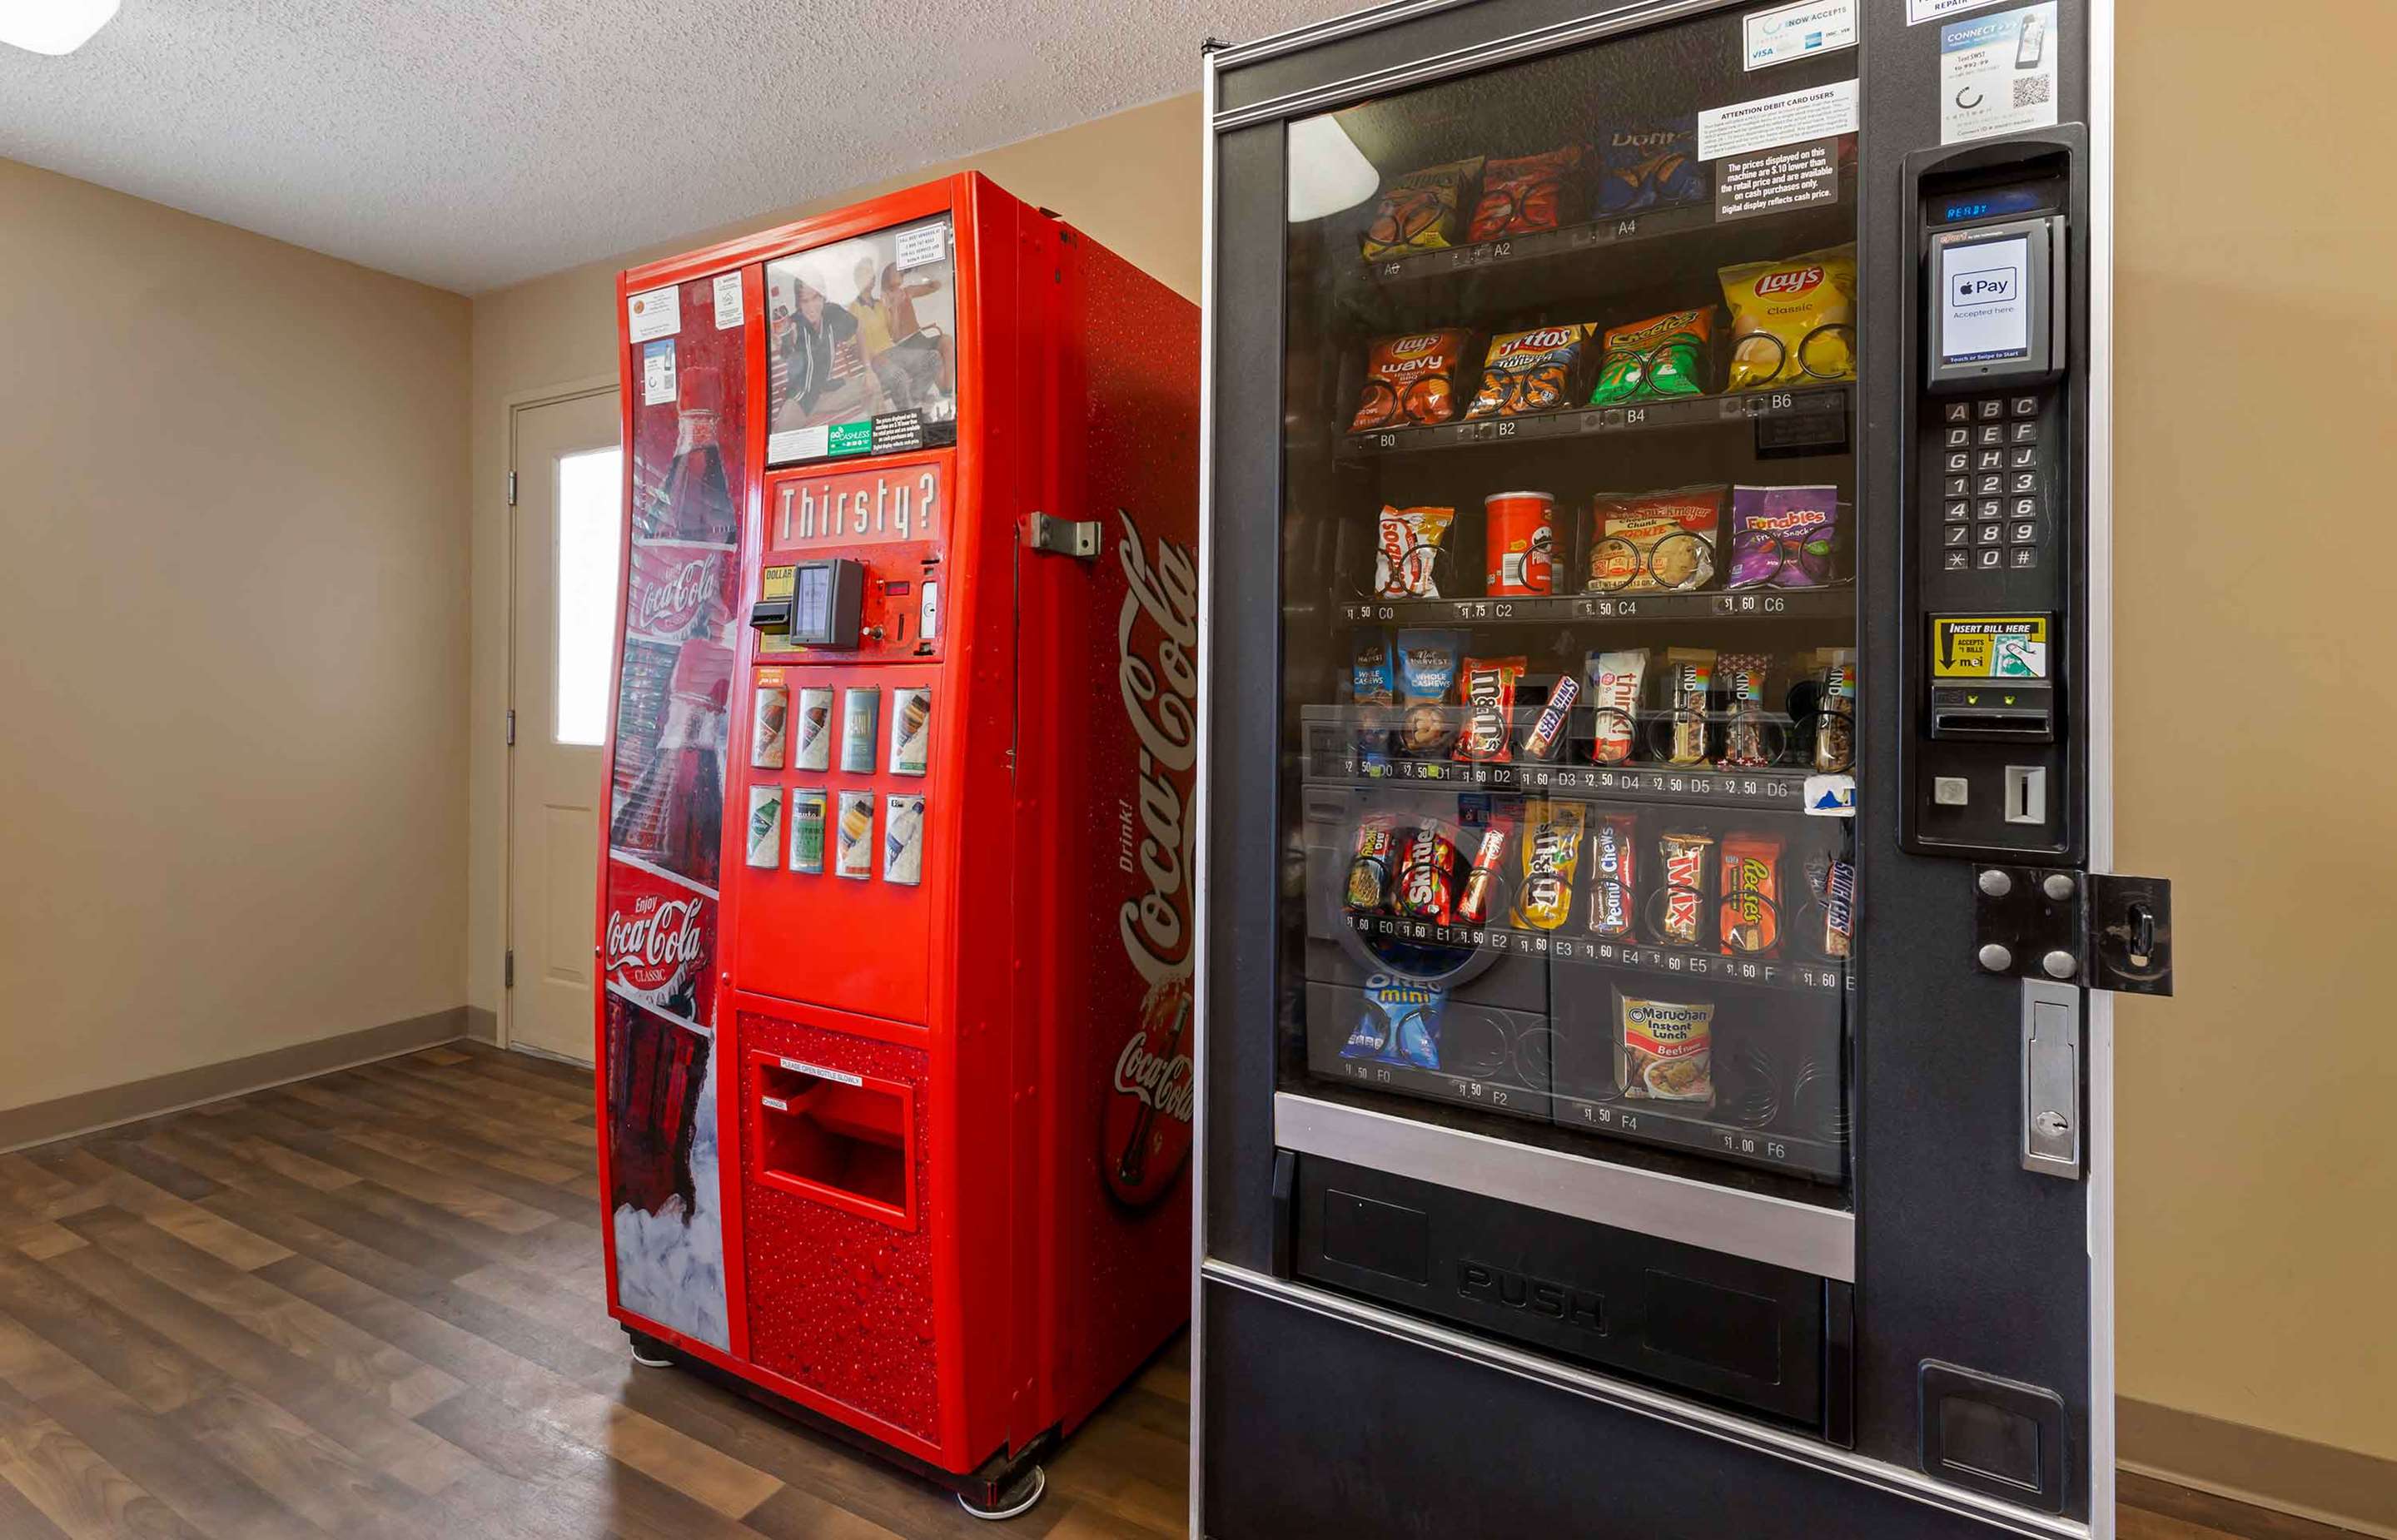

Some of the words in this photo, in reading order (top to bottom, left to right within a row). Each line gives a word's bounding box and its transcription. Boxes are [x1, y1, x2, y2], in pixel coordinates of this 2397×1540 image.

[1788, 17, 1809, 27] NOW
[1811, 7, 1847, 20] ACCEPTS
[1947, 25, 1997, 42] CONNECT
[1752, 48, 1773, 58] VISA
[1720, 107, 1763, 121] ATTENTION
[1763, 101, 1785, 112] DEBIT
[1786, 97, 1808, 107] CARD
[1809, 92, 1834, 102] USERS
[1728, 163, 1741, 173] The
[1742, 160, 1764, 173] prices
[1765, 152, 1799, 166] displayed
[1811, 147, 1826, 156] this
[1727, 171, 1757, 183] machine
[1758, 168, 1770, 176] are
[1788, 161, 1808, 171] lower
[1809, 158, 1826, 167] than
[1721, 184, 1732, 193] the
[1733, 181, 1751, 191] retail
[1752, 177, 1770, 191] price
[1772, 174, 1785, 184] and
[1787, 173, 1799, 181] are
[1800, 166, 1833, 178] available
[1734, 192, 1743, 201] on
[1744, 189, 1762, 199] cash
[1763, 182, 1800, 197] purchases
[1722, 205, 1743, 215] Digital
[1743, 200, 1766, 211] display
[1768, 196, 1793, 206] reflects
[1794, 192, 1811, 201] cash
[1619, 220, 1636, 235] A4
[1494, 243, 1511, 256] A2
[1758, 265, 1826, 294] Lay's
[1976, 280, 2008, 293] Pay
[1767, 303, 1813, 315] Classic
[1953, 309, 1992, 319] Accepted
[1995, 306, 2014, 315] here
[1380, 355, 1444, 374] wavy
[1977, 353, 1995, 361] Swipe
[1772, 394, 1792, 409] B6
[1628, 410, 1646, 423] B4
[1951, 405, 1966, 420] A
[1983, 403, 1999, 416] B
[2017, 400, 2032, 414] C
[1499, 423, 1515, 436] B2
[1951, 430, 1967, 444] D
[1984, 427, 1998, 441] E
[2017, 425, 2031, 439] F
[1380, 435, 1395, 447] B0
[1951, 454, 1967, 469] G
[1982, 452, 1999, 466] H
[2017, 449, 2031, 464] J
[1954, 479, 1964, 493] 1
[1983, 477, 1998, 491] 2
[2017, 474, 2032, 489] 3
[782, 472, 935, 539] Thirsty?
[1951, 503, 1965, 517] 4
[1984, 501, 1998, 515] 5
[2017, 499, 2032, 514] 6
[1627, 519, 1658, 529] Chunk
[1746, 510, 1826, 530] Funables
[1952, 528, 1966, 542] 7
[1983, 525, 1998, 540] 8
[2017, 524, 2032, 539] 9
[640, 552, 715, 628] Coca-Cola
[1496, 604, 1513, 617] C2
[1619, 601, 1636, 614] C4
[1764, 598, 1784, 612] C6
[1379, 607, 1395, 619] C0
[1949, 623, 1981, 633] INSERT
[1983, 624, 2004, 633] BILL
[2006, 624, 2031, 633] HERE
[1960, 656, 1983, 668] mei
[1411, 679, 1451, 688] CASHEWS
[1683, 664, 1697, 691] KIND
[1828, 667, 1843, 696] KIND
[1736, 672, 1749, 700] KIND
[1118, 507, 1197, 987] Coca-Cola
[1494, 770, 1511, 782] D2
[1559, 773, 1576, 786] D3
[1622, 776, 1639, 789] D4
[1691, 779, 1710, 792] D5
[1768, 783, 1788, 797] D6
[1119, 798, 1133, 874] Drink!
[1375, 832, 1385, 850] BIG
[1599, 826, 1618, 872] Chews
[1409, 818, 1439, 905] Skittles
[1668, 847, 1701, 928] TWIX
[635, 895, 658, 913] Enjoy
[606, 897, 704, 971] Coca-Cola
[1380, 921, 1394, 933] E0
[1437, 928, 1450, 941] E1
[1492, 935, 1507, 947] E2
[1556, 942, 1572, 956] E3
[1623, 951, 1639, 964] E4
[1689, 958, 1707, 972] E5
[634, 968, 666, 982] CLASSIC
[1380, 988, 1430, 1003] mini
[1643, 1006, 1707, 1021] Maruchan
[1648, 1020, 1693, 1031] Instant
[1653, 1030, 1688, 1040] Lunch
[1658, 1046, 1682, 1056] Beef
[782, 1061, 801, 1071] PLEASE
[802, 1065, 817, 1074] OPEN
[817, 1069, 837, 1079] BOTTLE
[837, 1073, 859, 1084] SLOWLY
[1493, 1091, 1508, 1105] F2
[1622, 1115, 1637, 1130] F4
[1768, 1142, 1785, 1158] F6
[1457, 1259, 1609, 1337] PUSH
